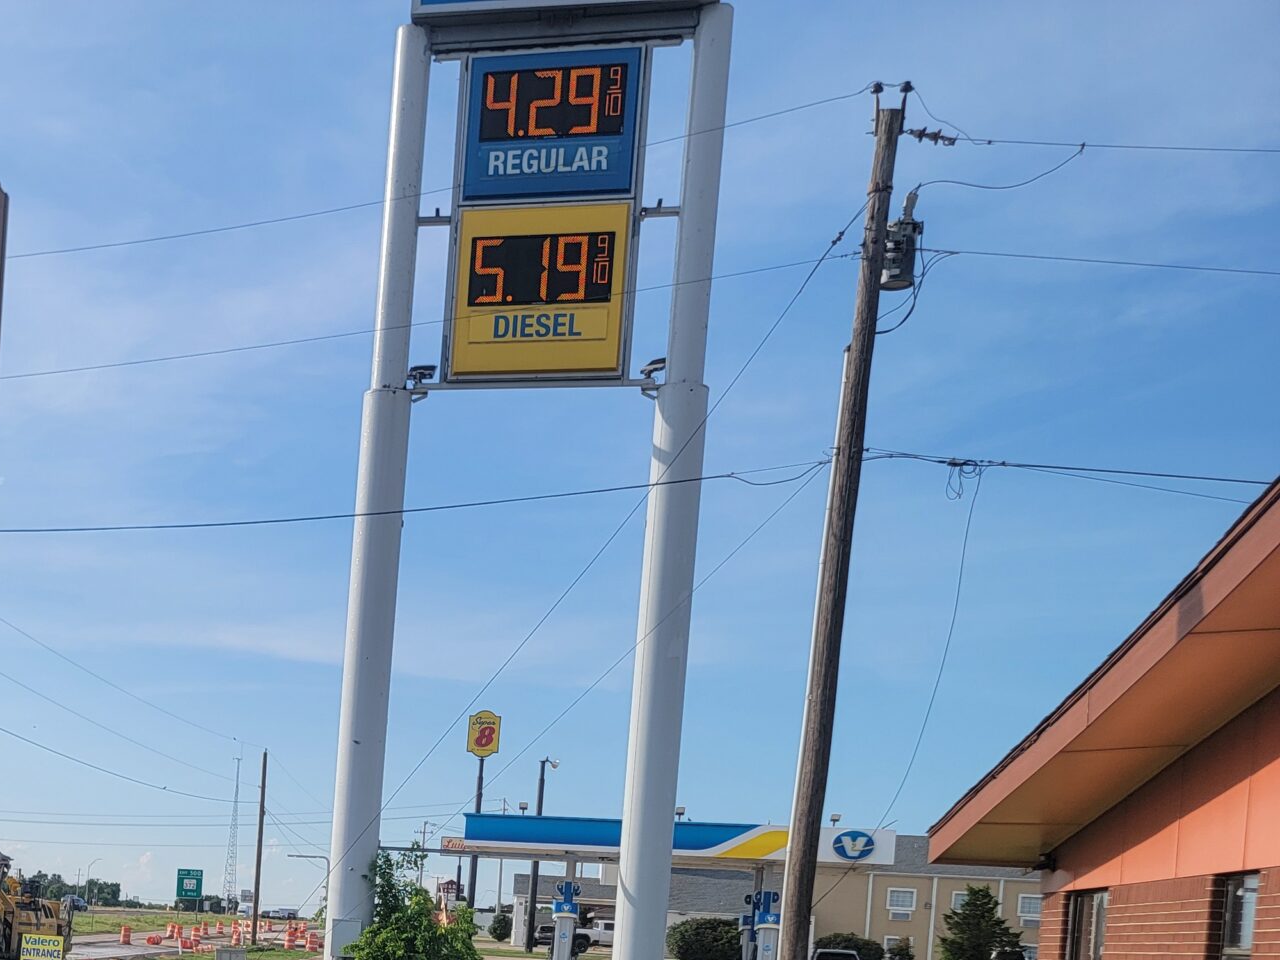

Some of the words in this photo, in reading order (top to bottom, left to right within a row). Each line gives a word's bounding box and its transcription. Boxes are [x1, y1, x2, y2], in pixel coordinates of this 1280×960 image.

[485, 66, 601, 137] 4.29
[487, 145, 609, 176] REGULAR
[474, 235, 588, 303] 5.19
[492, 312, 582, 339] DIESEL
[475, 726, 495, 747] 8
[21, 947, 61, 959] ENTRANCE
[24, 936, 60, 947] Valero
